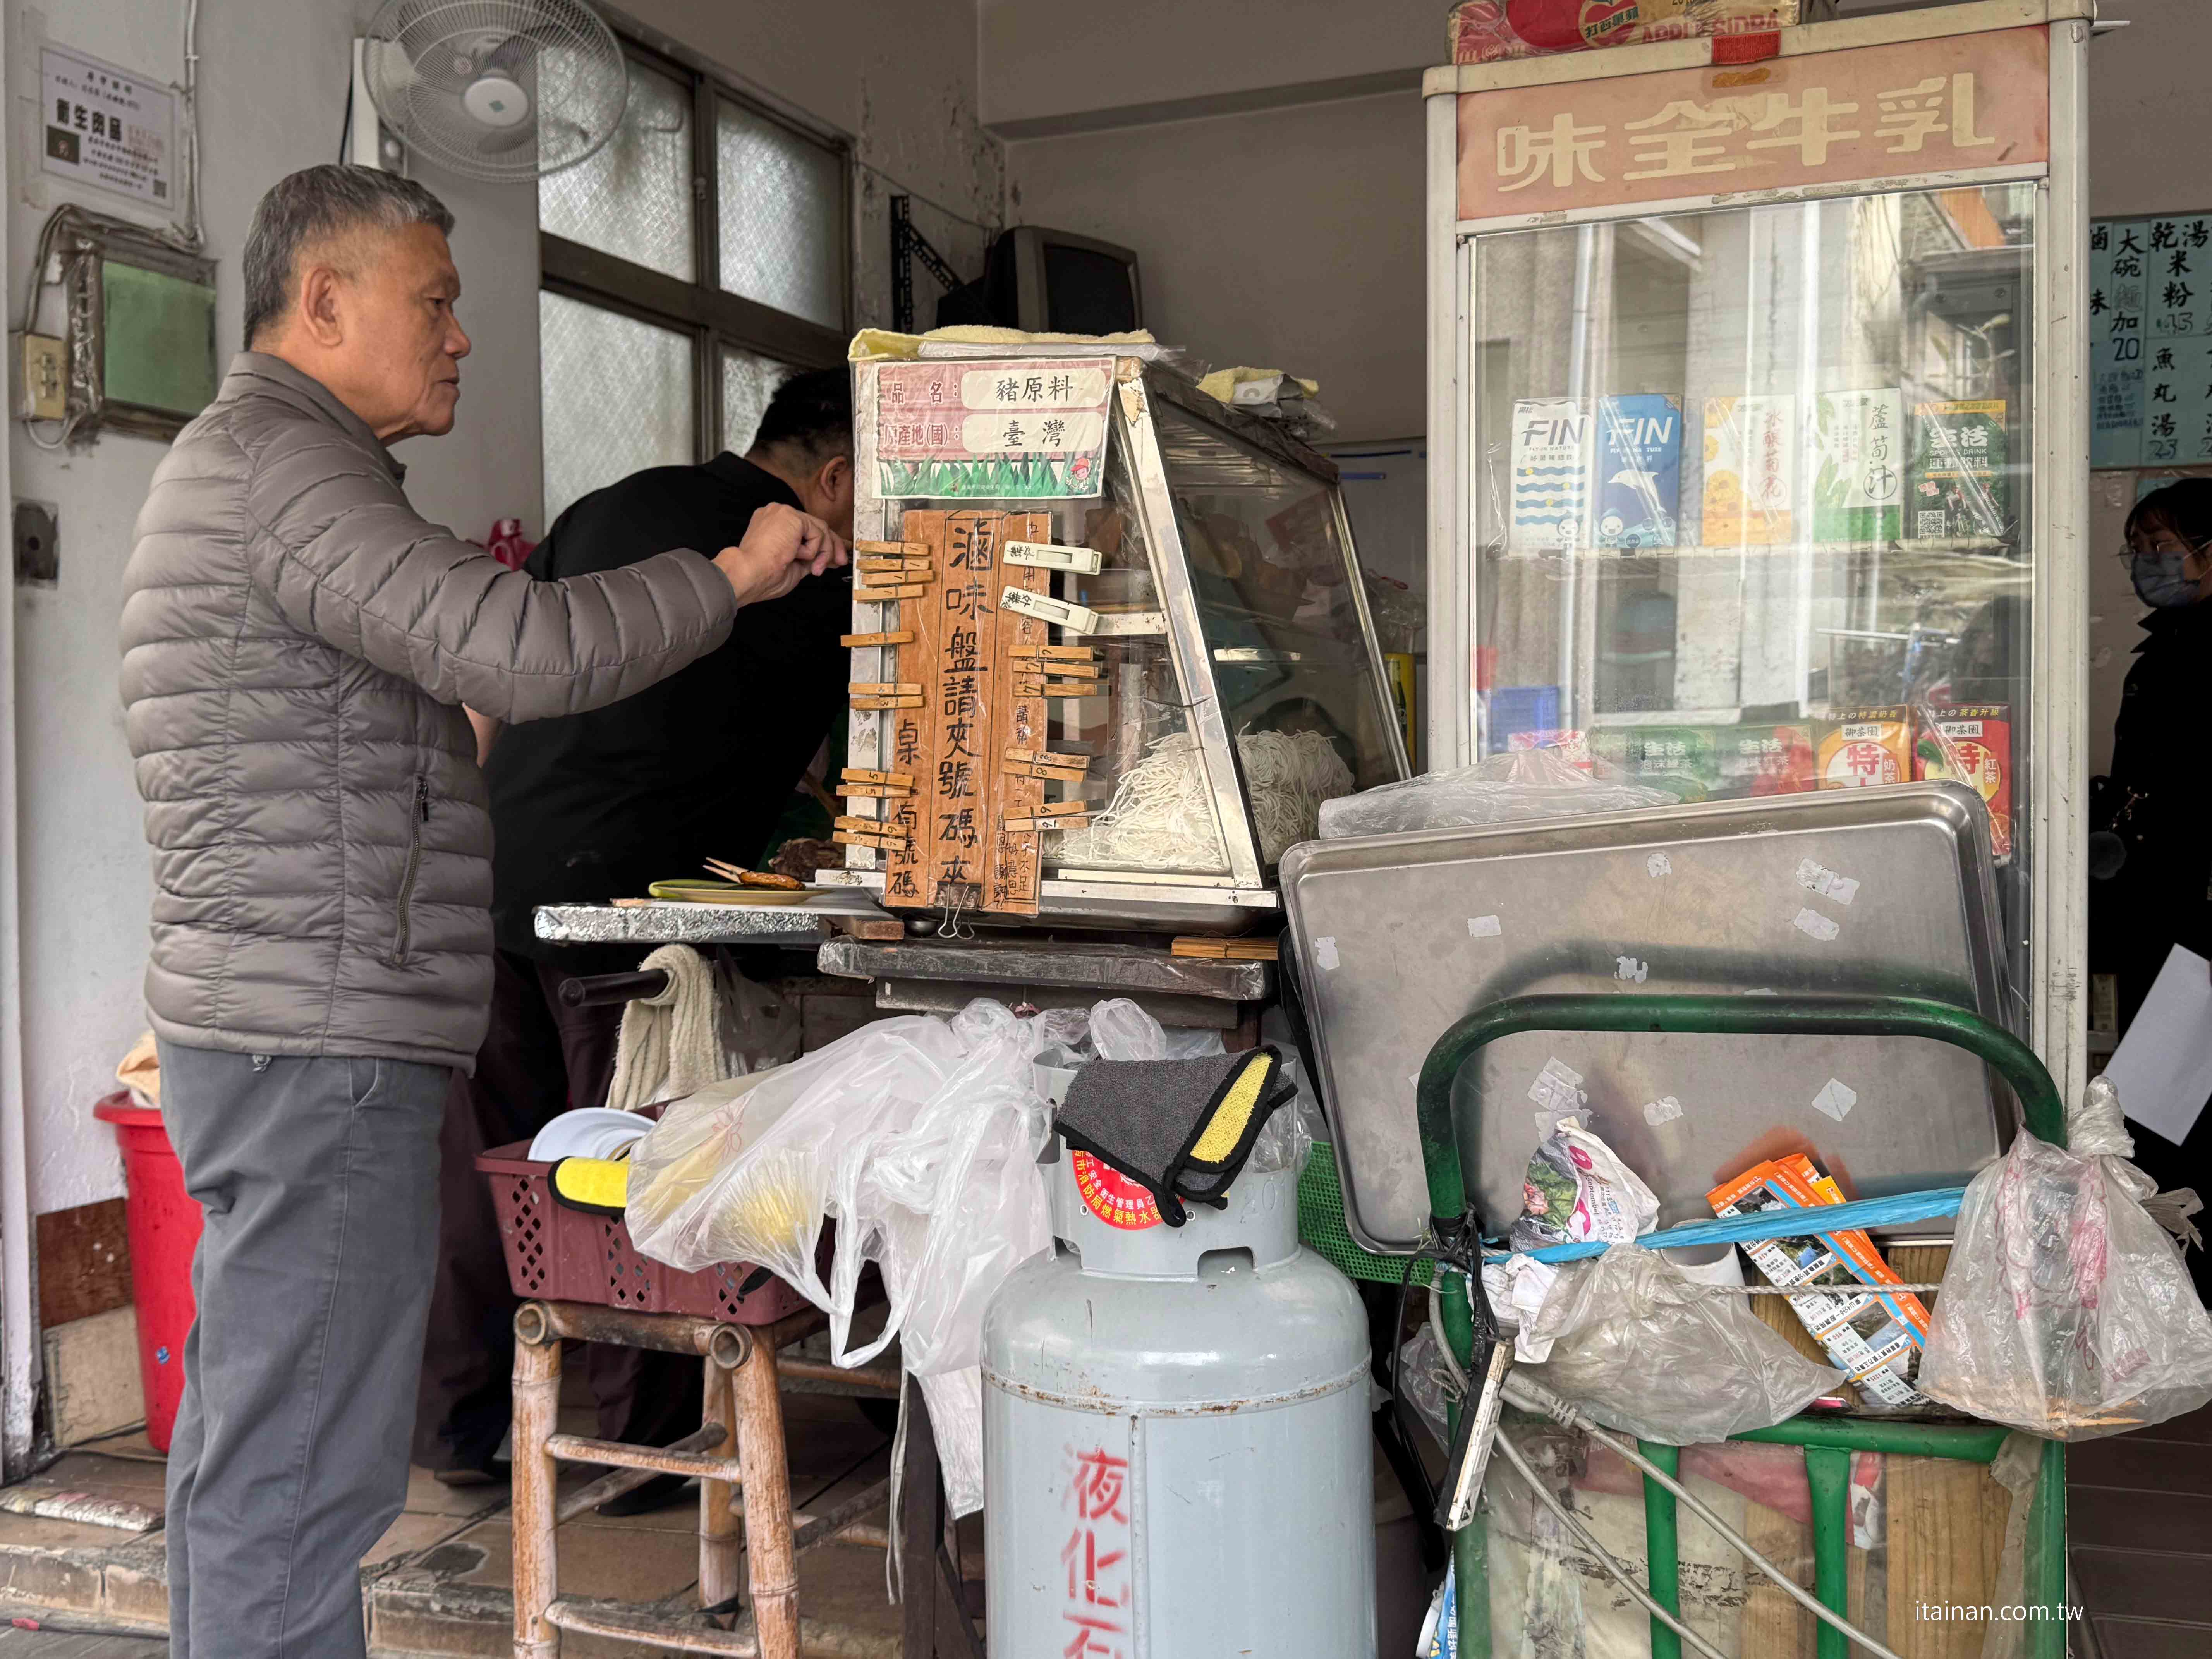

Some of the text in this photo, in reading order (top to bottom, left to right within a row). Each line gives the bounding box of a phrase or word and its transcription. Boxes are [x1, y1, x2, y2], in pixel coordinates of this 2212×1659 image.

[1495, 72, 1995, 192] 味全牛乳
[995, 375, 1073, 402] 豬原料
[2152, 347, 2177, 437] 魚丸湯
[1003, 419, 1066, 447] 臺灣
[1521, 417, 1585, 446] FIN
[1606, 417, 1673, 445] FIN
[1869, 403, 1894, 496] 蘆筍汁
[1644, 740, 1686, 757] 生活
[1738, 738, 1783, 754] 生活
[1984, 758, 1997, 784] 紅茶
